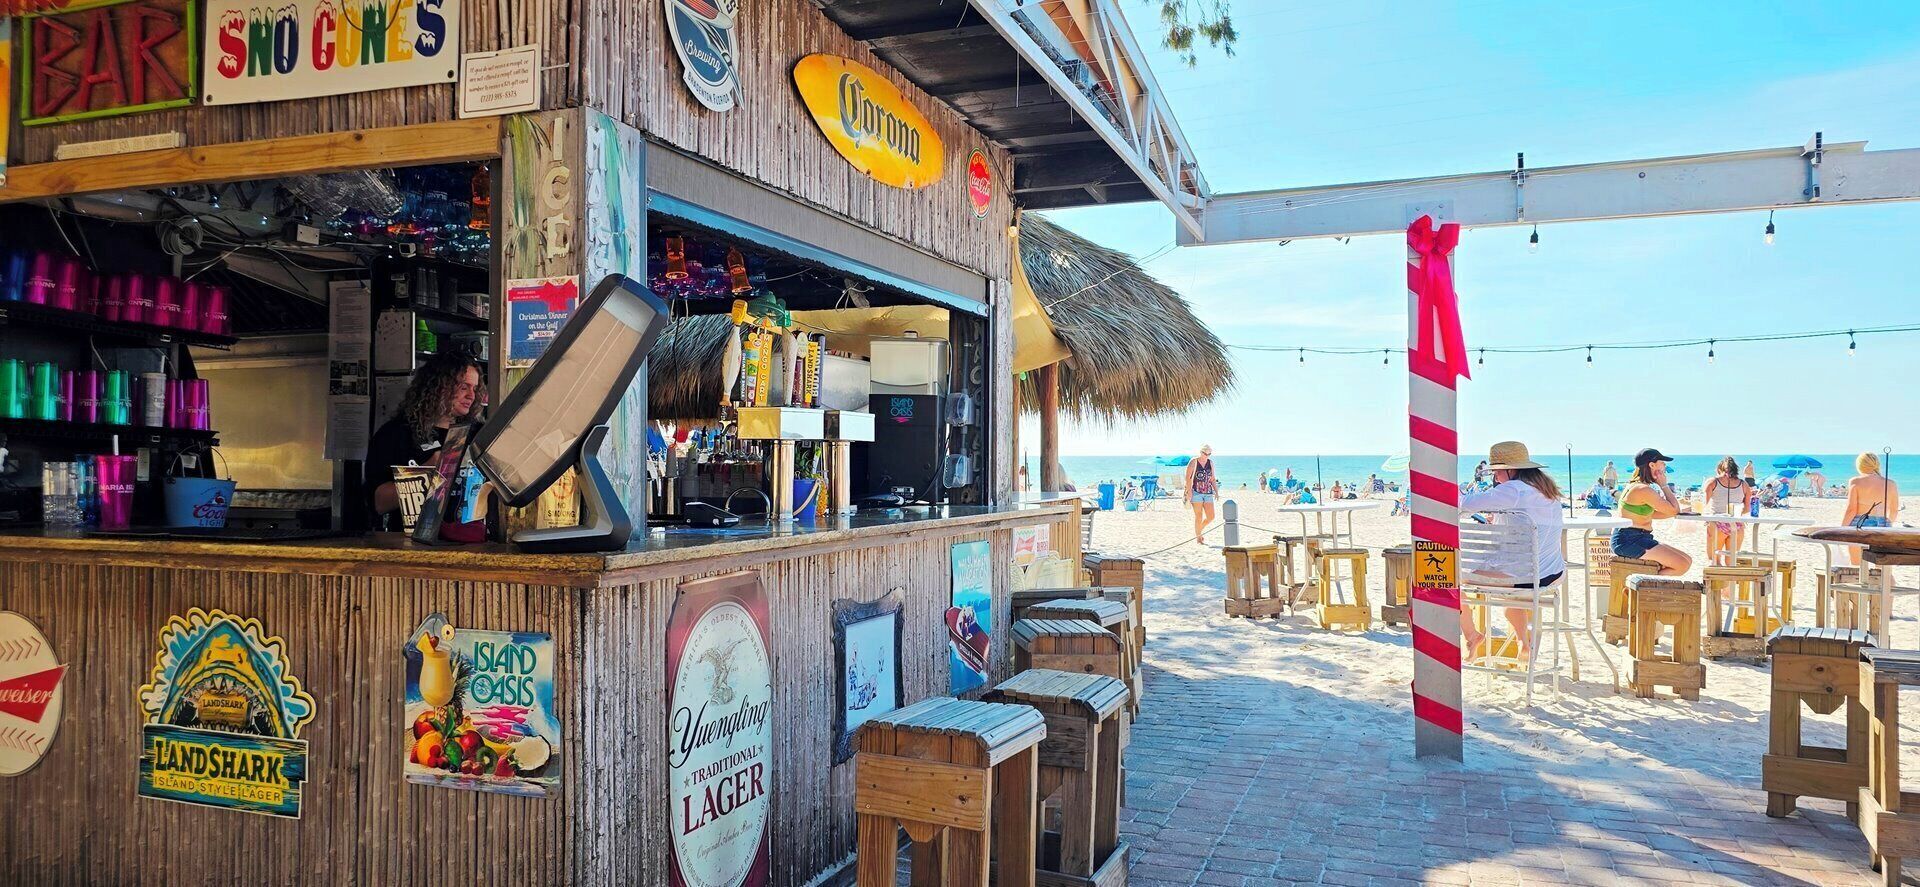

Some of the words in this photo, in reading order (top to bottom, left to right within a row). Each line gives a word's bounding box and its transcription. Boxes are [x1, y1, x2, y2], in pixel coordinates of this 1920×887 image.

[217, 3, 299, 79] SNO
[311, 0, 446, 71] CONES
[33, 5, 184, 116] BAR
[685, 39, 722, 74] Brewing
[839, 72, 921, 166] Corona
[518, 312, 548, 321] Christmas
[546, 321, 559, 331] Gulf
[761, 334, 770, 370] MANGO
[759, 373, 767, 401] CART
[806, 348, 814, 395] LANDSHARK
[890, 406, 913, 417] OASIS
[891, 397, 914, 408] ISLAND
[396, 480, 425, 494] DRINK
[399, 492, 426, 515] TIP
[199, 519, 225, 527] LIGH
[1423, 573, 1448, 581] WATCH
[710, 613, 738, 626] OLDEST
[474, 641, 537, 675] ISLAND
[202, 698, 244, 710] LANDSHARK
[470, 673, 534, 707] OASIS
[669, 686, 771, 769] Yuengling
[154, 740, 282, 785] LANDSHARK
[690, 744, 759, 785] TRADITIONAL
[154, 776, 195, 790] ISLAND
[200, 782, 236, 795] STYLE
[242, 788, 281, 801] LAGER
[682, 761, 765, 836] LAGER
